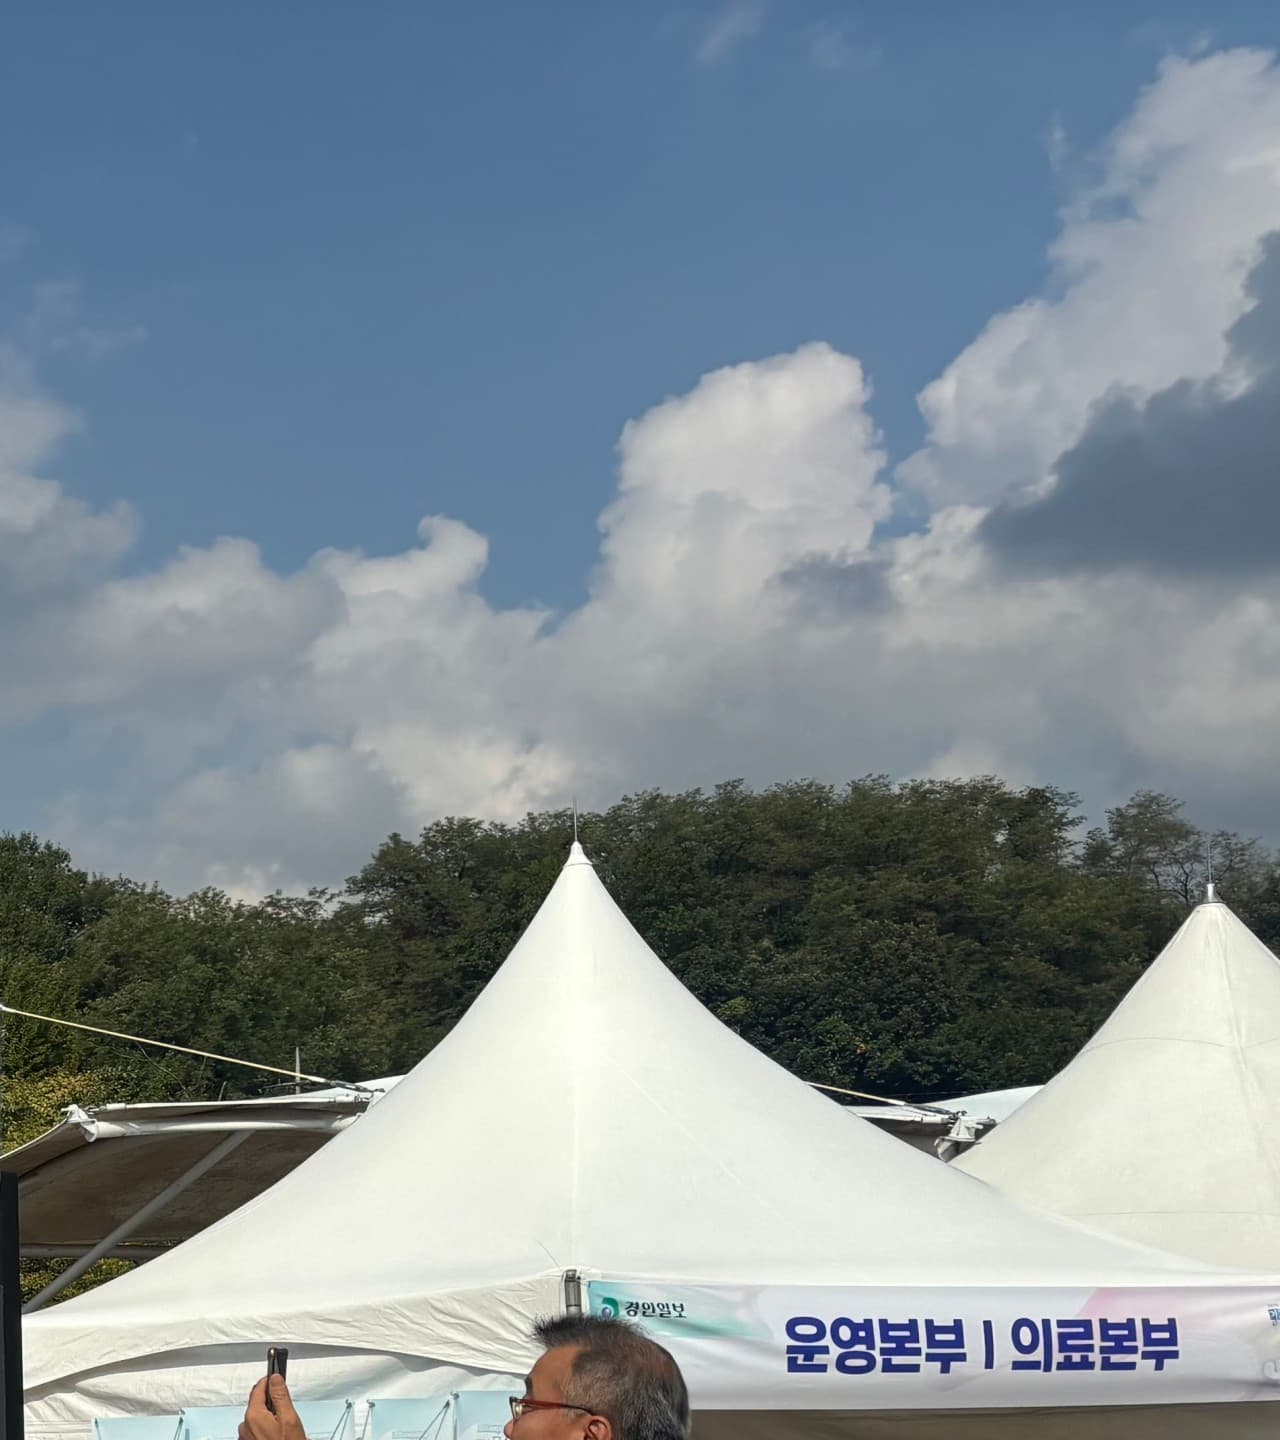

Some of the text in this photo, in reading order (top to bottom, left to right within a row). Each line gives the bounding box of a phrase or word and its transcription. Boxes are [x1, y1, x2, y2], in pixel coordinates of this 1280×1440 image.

[624, 1301, 687, 1318] 경인일보
[784, 1316, 967, 1375] 운영본부
[1011, 1316, 1180, 1373] 의료본부
